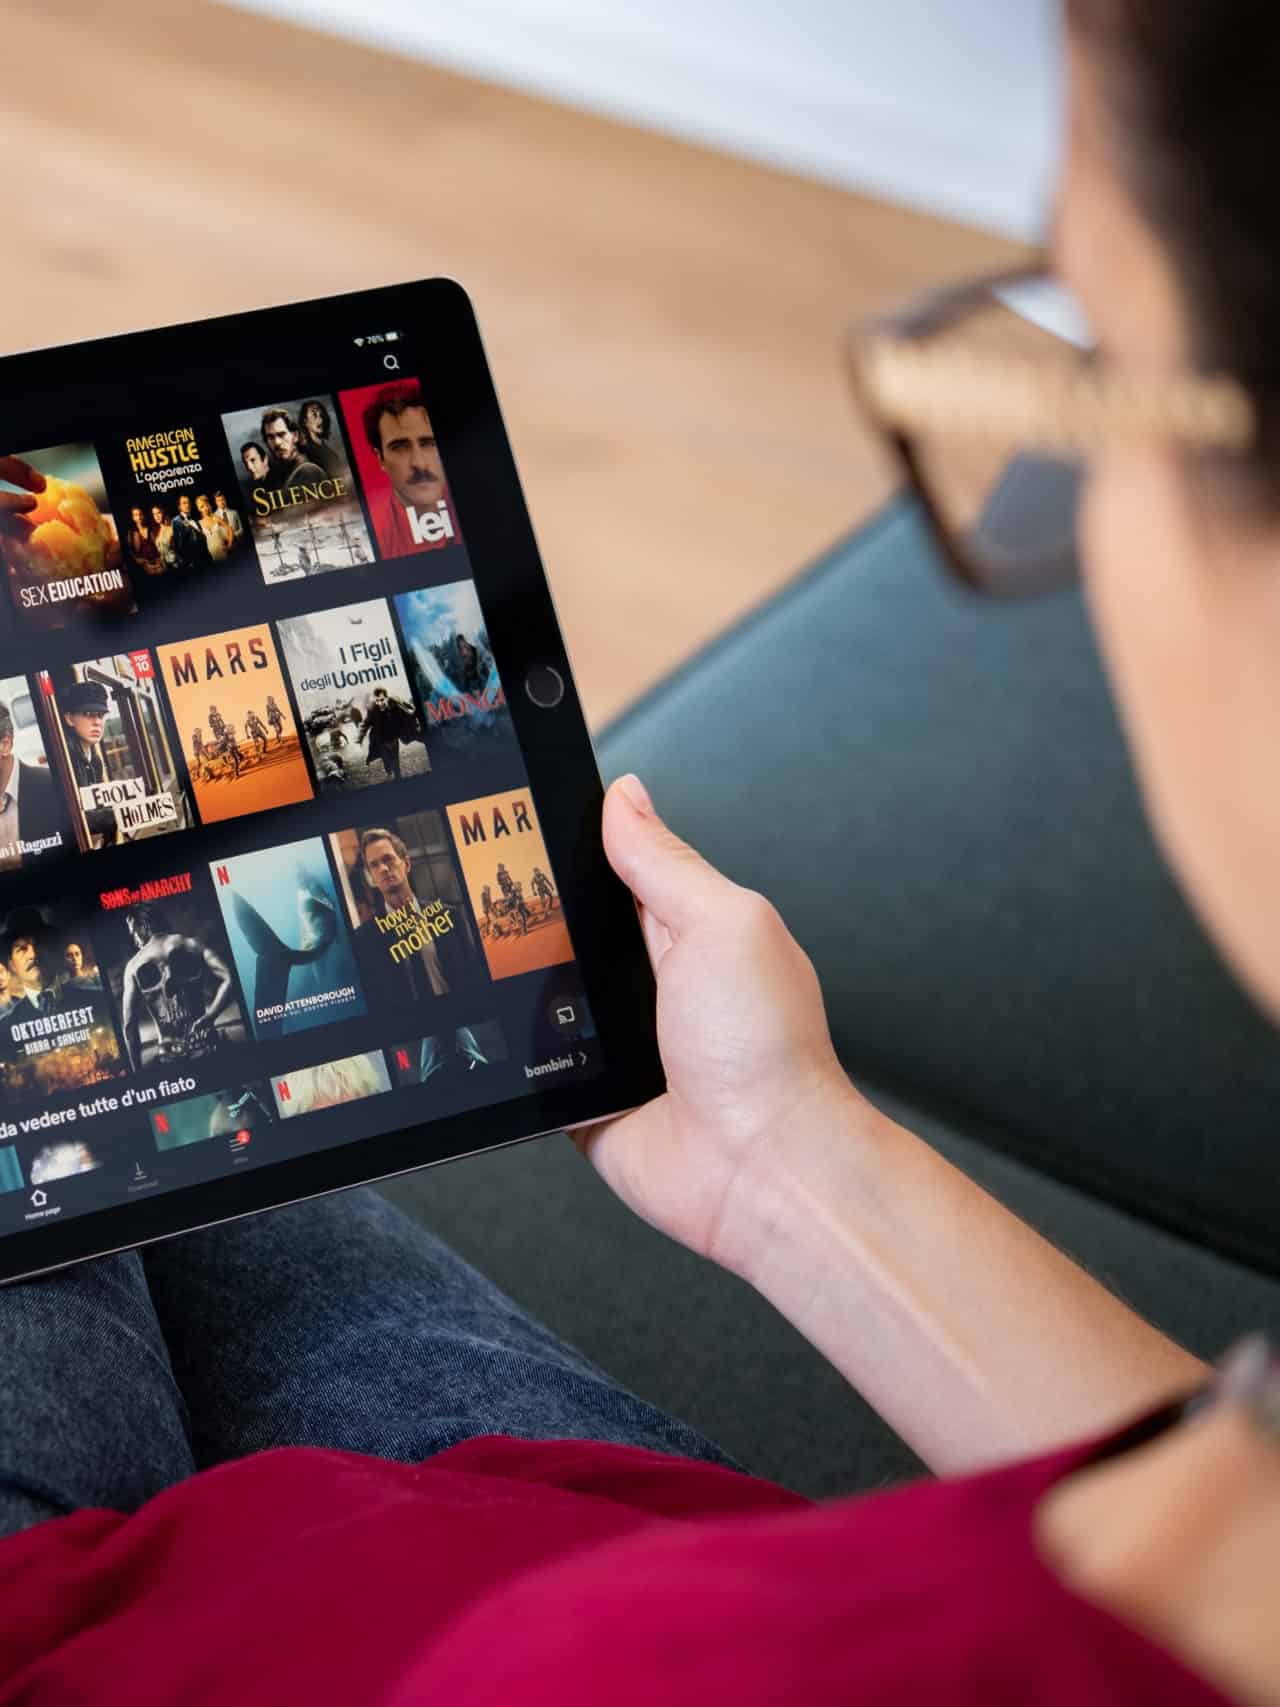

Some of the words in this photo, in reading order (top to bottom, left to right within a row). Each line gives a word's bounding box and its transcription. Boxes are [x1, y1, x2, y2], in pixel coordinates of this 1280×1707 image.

[126, 427, 194, 452] AMERICAN
[130, 441, 200, 472] HUSTLE
[135, 463, 202, 483] L'apparenza
[253, 479, 347, 517] SILENCE
[406, 500, 454, 544] lei
[20, 584, 49, 608] SEX
[48, 569, 124, 602] EDUCATION
[136, 661, 150, 673] 10
[170, 638, 268, 687] MARS
[339, 647, 347, 665] I
[350, 637, 392, 662] Figli
[301, 672, 332, 691] degli
[331, 659, 398, 689] Uomini
[460, 800, 532, 846] MAR
[16, 831, 63, 856] Ragazzi
[100, 887, 129, 911] SONS
[140, 872, 192, 901] ANARCHY
[374, 905, 407, 934] how
[394, 914, 418, 936] met
[420, 897, 444, 921] your
[389, 909, 454, 964] mother
[256, 1004, 284, 1018] DAVID
[284, 985, 355, 1012] ATTENBOROUGH
[10, 1006, 94, 1042] OKTOBERFEST
[56, 1028, 91, 1047] SANGUE
[525, 1053, 574, 1078] bambini
[19, 1106, 77, 1133] vedere
[78, 1097, 119, 1118] tutte
[121, 1088, 157, 1107] d'un
[158, 1076, 196, 1097] fiato
